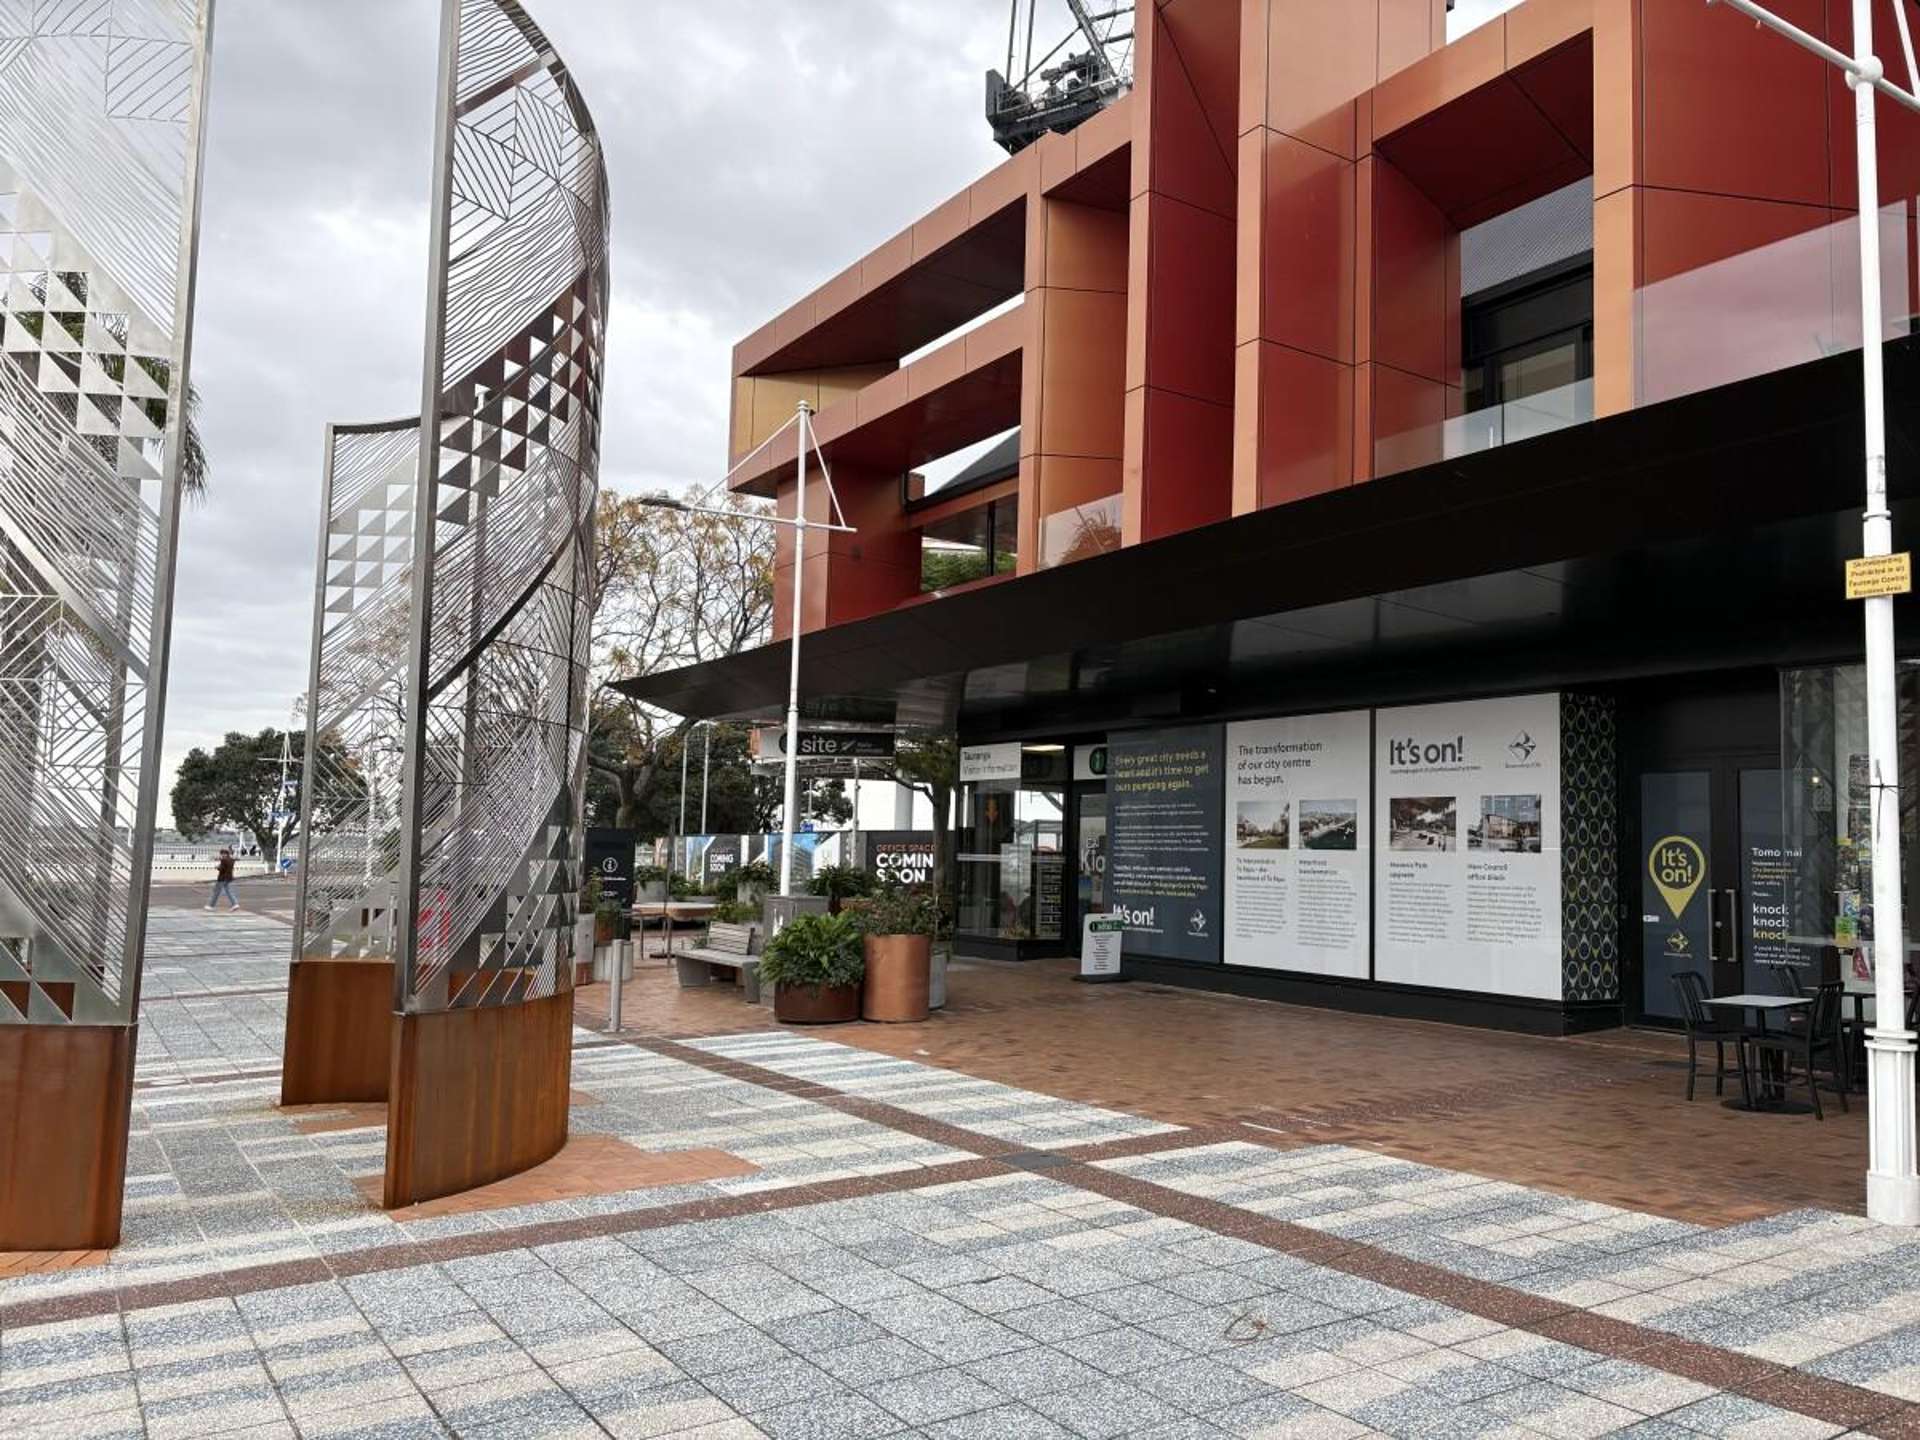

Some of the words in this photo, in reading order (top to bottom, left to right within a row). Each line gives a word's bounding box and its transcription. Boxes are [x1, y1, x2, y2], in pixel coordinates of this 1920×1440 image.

[801, 734, 837, 753] site
[1239, 744, 1254, 756] The
[1255, 741, 1323, 755] transformation
[1389, 736, 1421, 766] It's
[1423, 735, 1464, 764] on!
[1136, 753, 1158, 766] great
[1158, 751, 1174, 764] city
[1175, 750, 1199, 761] needs
[1238, 759, 1248, 770] of
[1248, 761, 1263, 770] our
[1264, 758, 1281, 770] city
[1282, 758, 1312, 769] centre
[1183, 764, 1193, 773] to
[1238, 775, 1253, 786] has
[876, 843, 907, 853] OFFICE
[1751, 847, 1781, 858] Tomo
[1783, 846, 1803, 857] mai
[710, 853, 734, 864] COMING
[876, 852, 934, 869] COMIN
[1081, 848, 1106, 873] Kio
[1662, 847, 1688, 867] It's
[710, 863, 726, 873] SOON
[1661, 865, 1692, 884] on!
[1752, 902, 1789, 916] knock
[1131, 906, 1155, 927] on!
[1752, 915, 1789, 929] knock
[1752, 928, 1790, 941] knock
